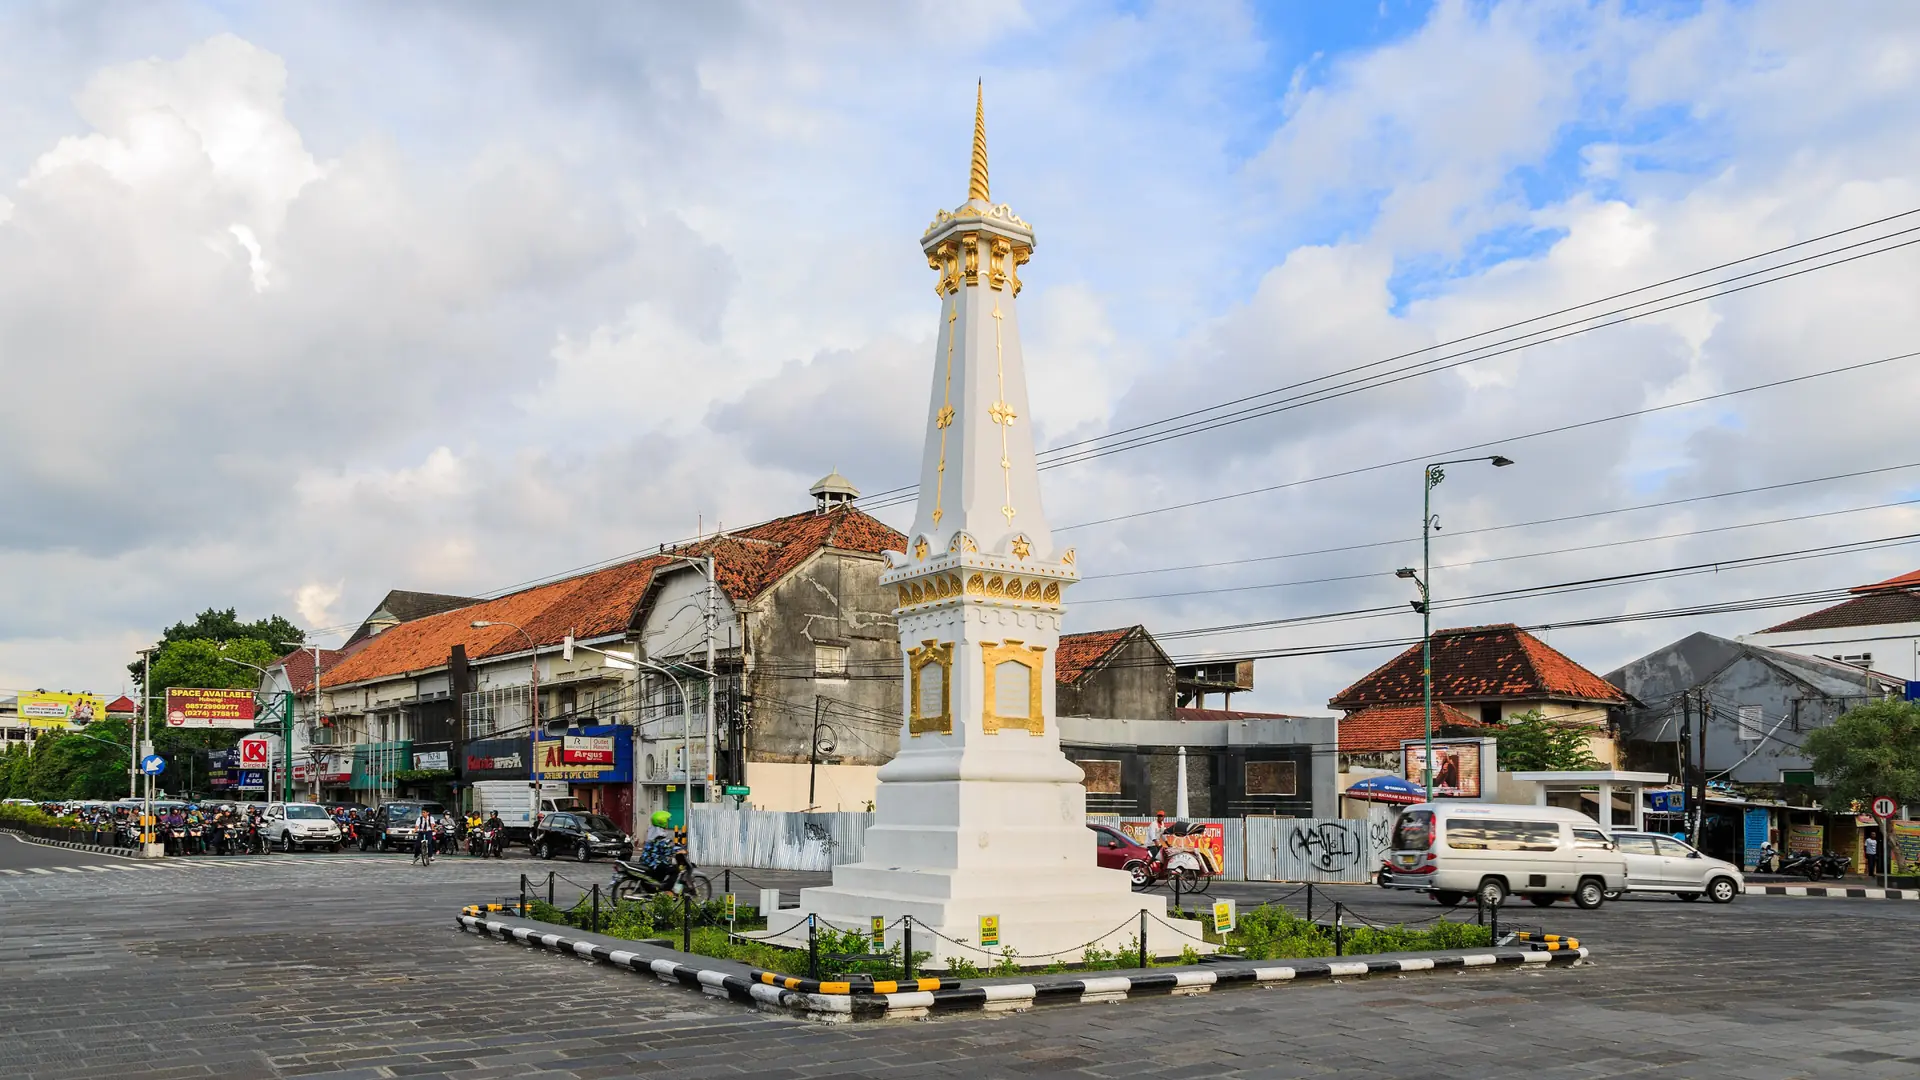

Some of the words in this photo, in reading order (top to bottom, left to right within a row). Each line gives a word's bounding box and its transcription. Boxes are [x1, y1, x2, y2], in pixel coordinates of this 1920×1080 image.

[171, 689, 200, 697] SPACE
[203, 690, 252, 699] AVAILABLE
[574, 750, 603, 760] Argus
